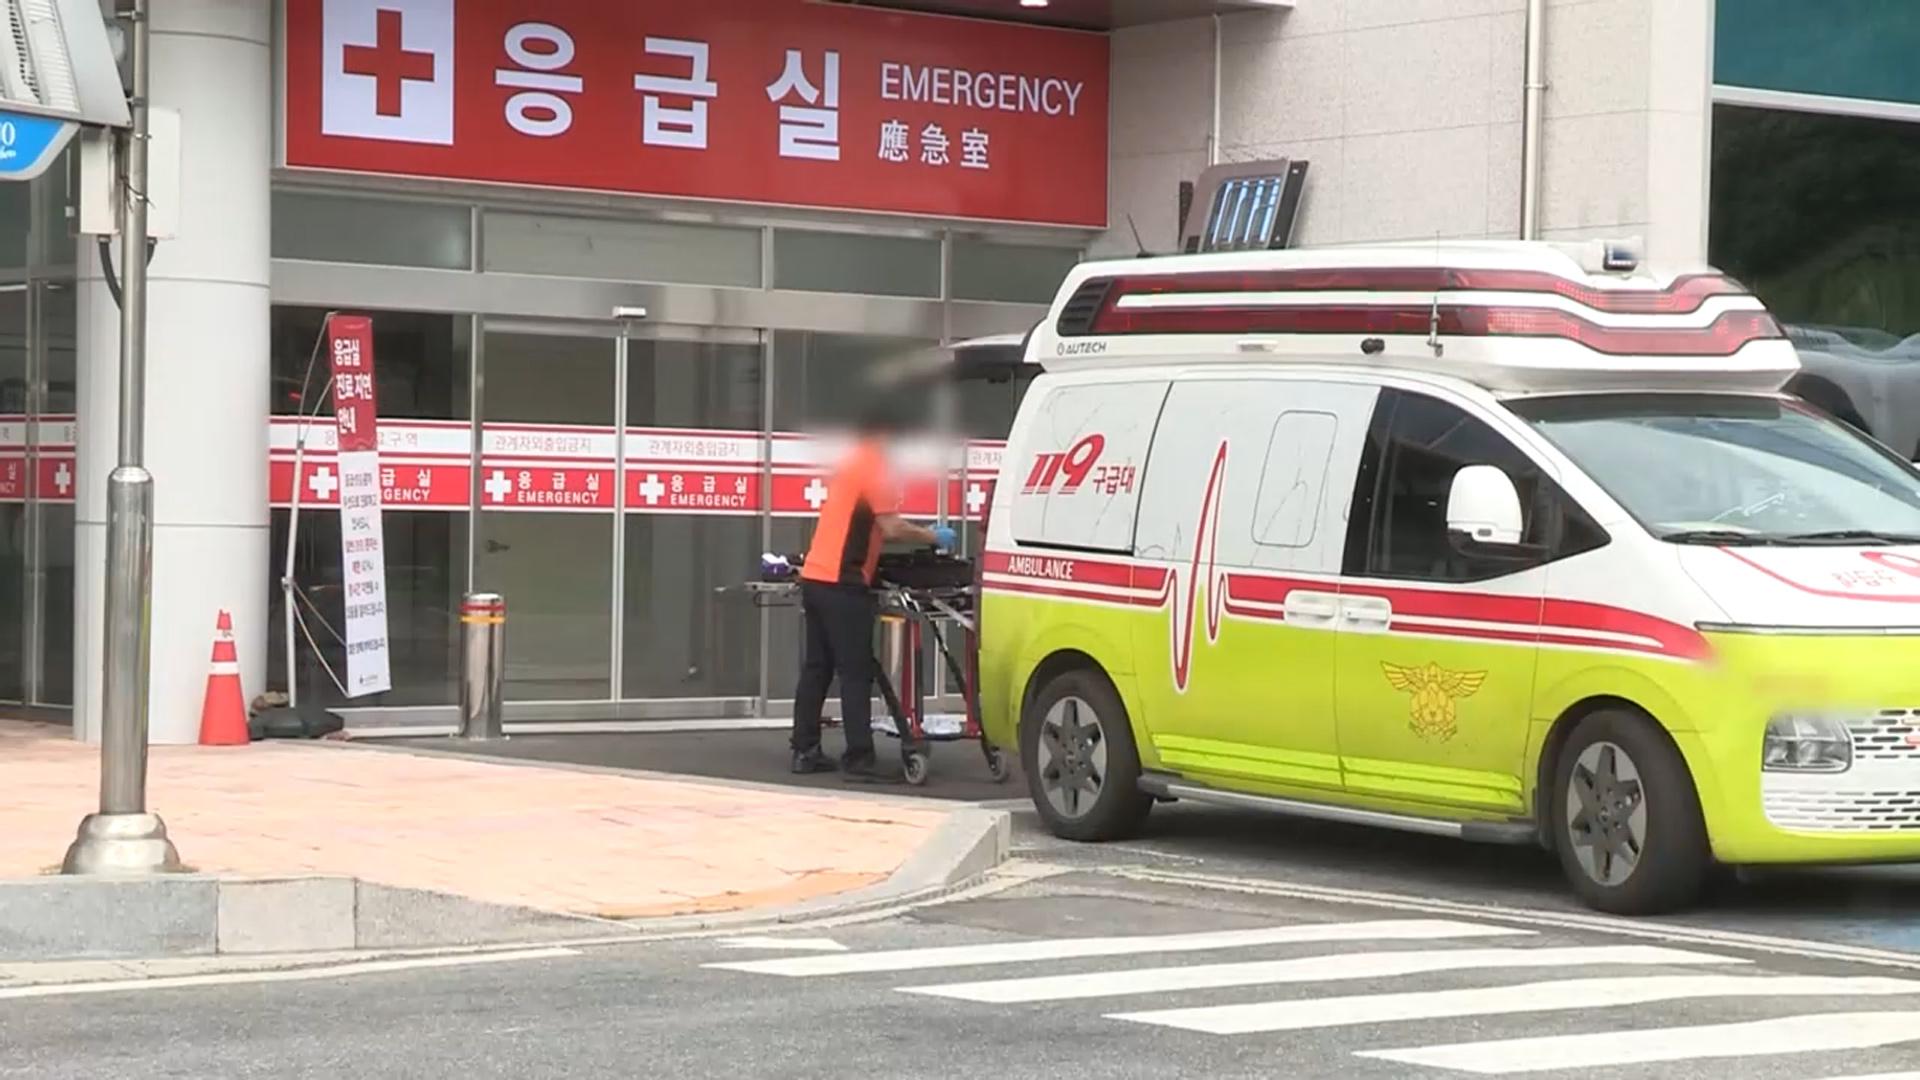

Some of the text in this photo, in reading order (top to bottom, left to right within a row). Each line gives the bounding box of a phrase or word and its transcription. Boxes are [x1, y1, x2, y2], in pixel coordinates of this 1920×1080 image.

[881, 63, 1083, 116] EMERGENCY
[878, 119, 989, 169] 應急室
[334, 338, 360, 366] 응급실
[336, 373, 372, 401] 진료 지연
[337, 406, 357, 434] 안내
[1021, 434, 1105, 495] 119
[1093, 466, 1136, 494] 구급대
[383, 488, 430, 502] GENCY
[517, 491, 599, 505] EMERGENCY
[670, 493, 747, 507] EMERGENCY
[1008, 556, 1074, 580] AMBULANCE
